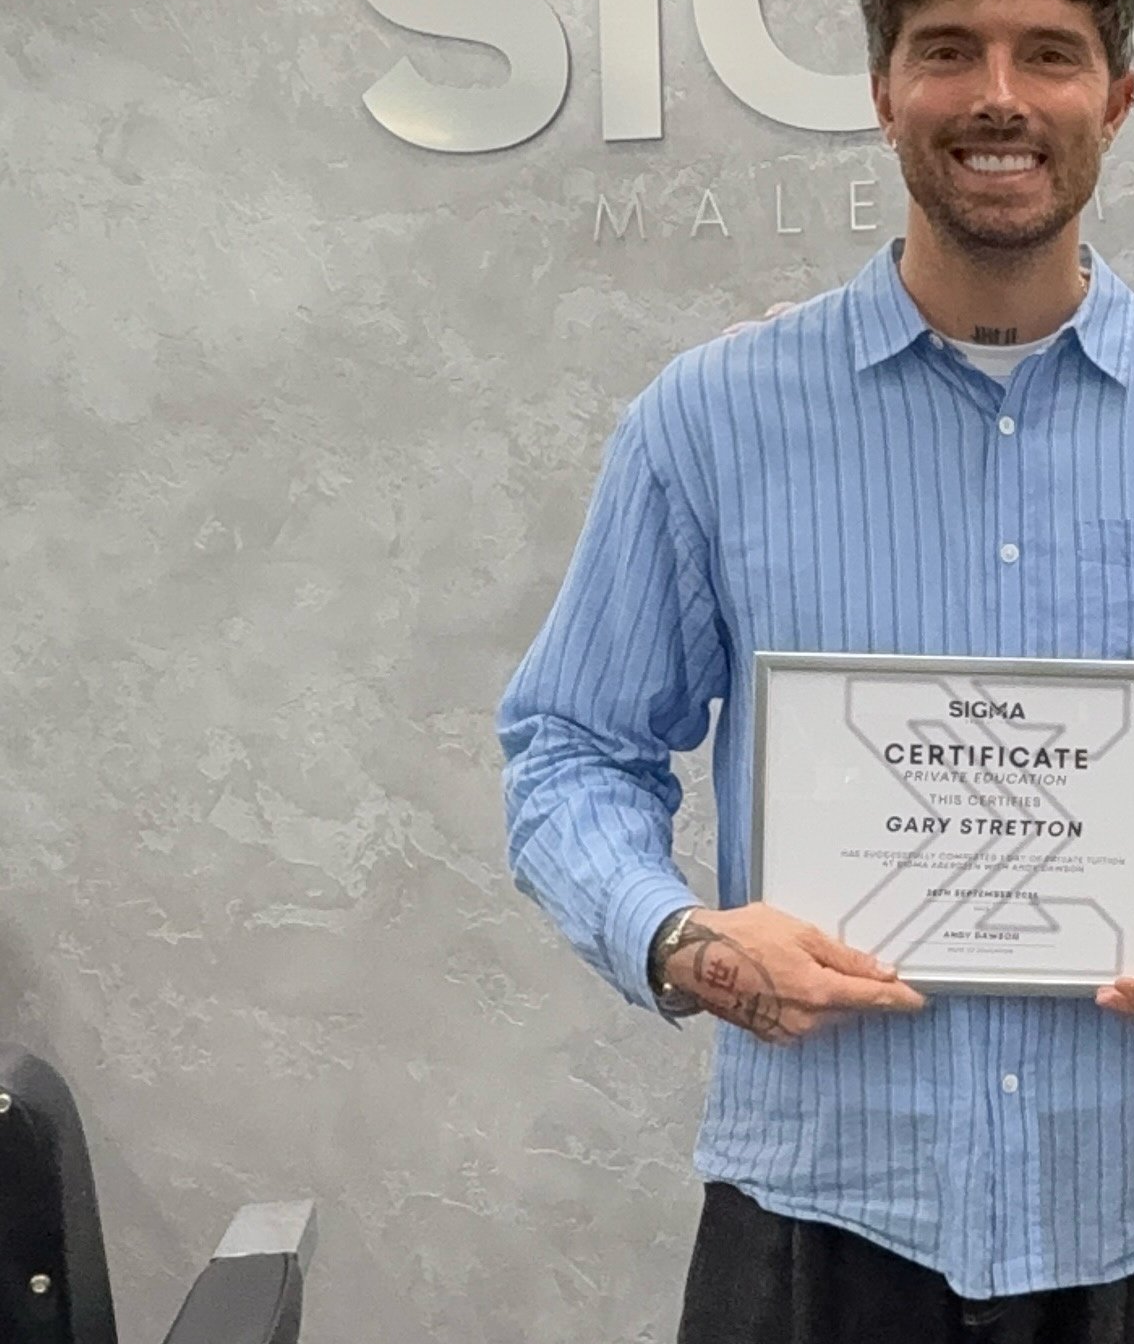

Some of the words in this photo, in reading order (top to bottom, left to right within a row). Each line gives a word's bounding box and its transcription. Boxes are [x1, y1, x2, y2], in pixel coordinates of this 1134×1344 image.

[593, 180, 879, 242] MALE
[949, 700, 1026, 721] SIGMA
[884, 743, 1089, 770] CERTIFICATE
[903, 770, 968, 783] PRIVATE
[974, 772, 1068, 786] EDUCATION
[929, 793, 962, 806] THIS
[968, 794, 1041, 808] CERTIFIES
[885, 815, 952, 834] GARY
[959, 817, 1084, 838] STRETTON
